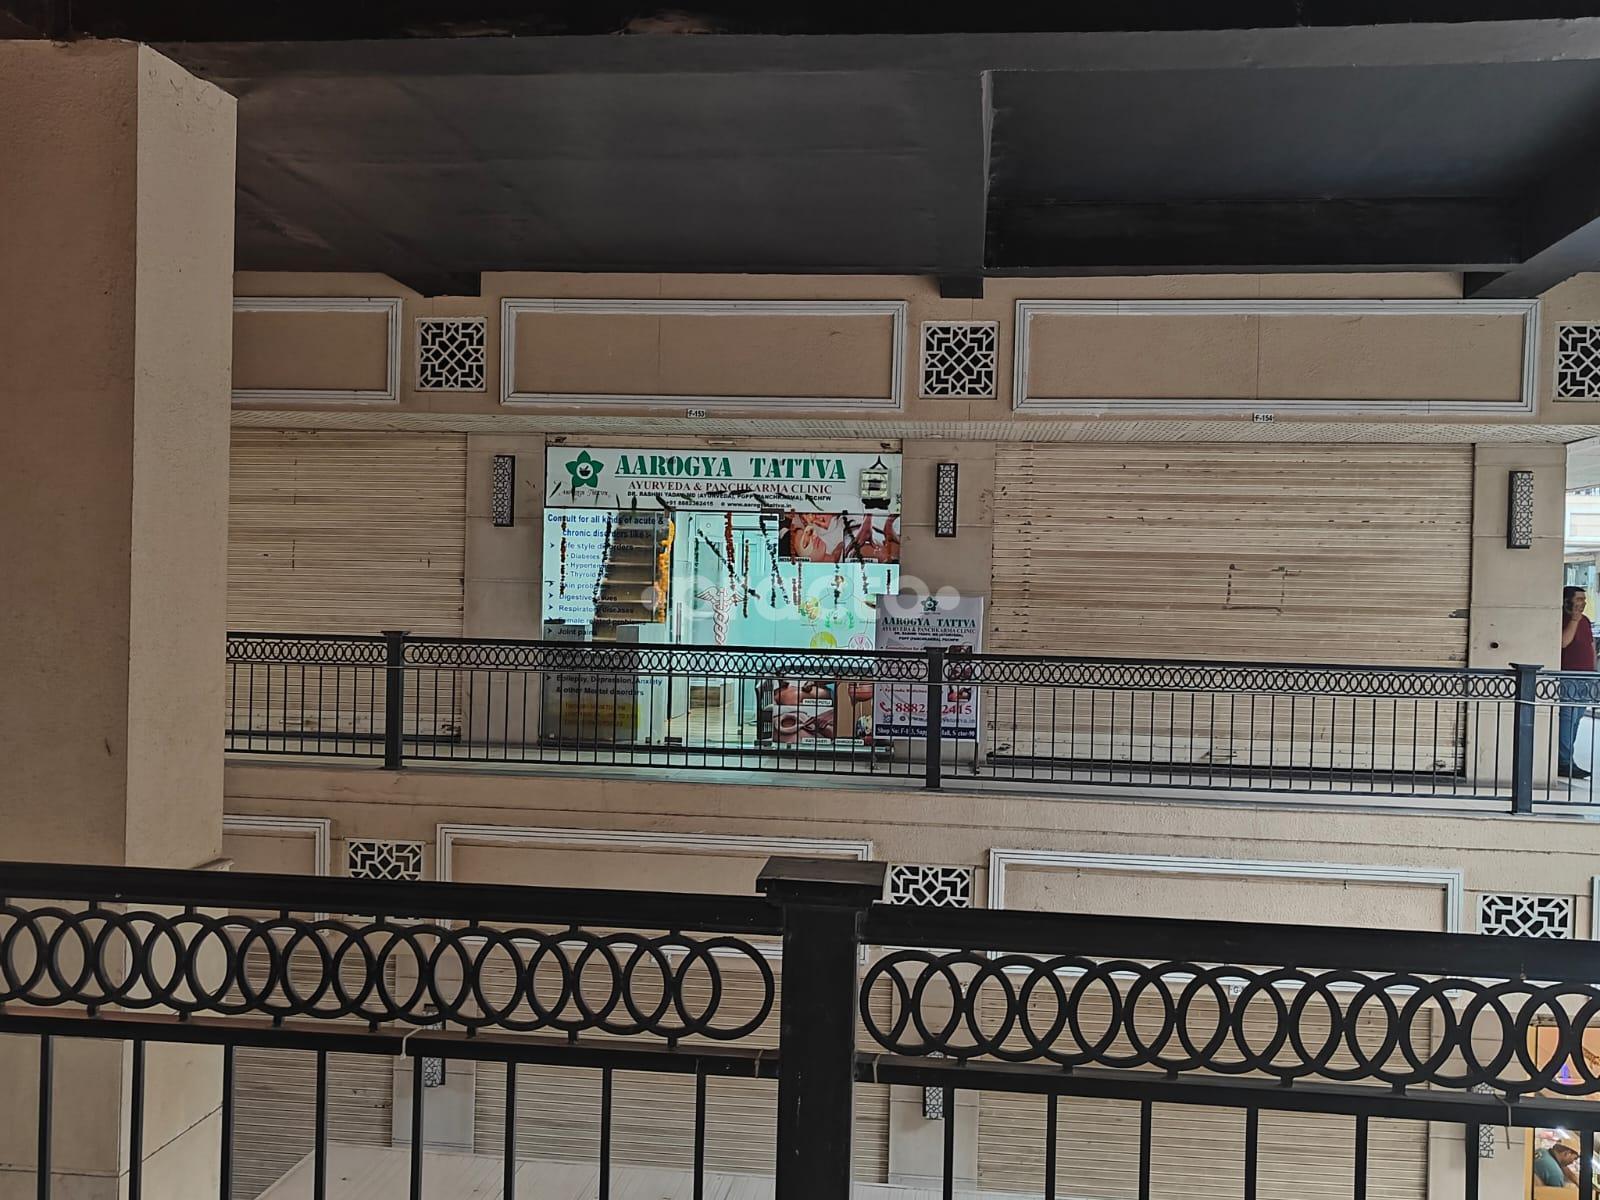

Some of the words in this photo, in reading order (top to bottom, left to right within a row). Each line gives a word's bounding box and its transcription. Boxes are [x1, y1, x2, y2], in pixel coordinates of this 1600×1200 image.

[614, 455, 733, 477] AAROGYA
[750, 457, 846, 479] TATTVA
[628, 480, 691, 491] AYURVEDA
[693, 482, 702, 491] &
[706, 482, 788, 493] PANCHKARMA
[791, 484, 832, 495] CLINIC
[548, 513, 576, 522] Conult
[562, 529, 591, 537] chronic
[881, 617, 931, 626] AAROGYA
[937, 618, 977, 628] TATTVA
